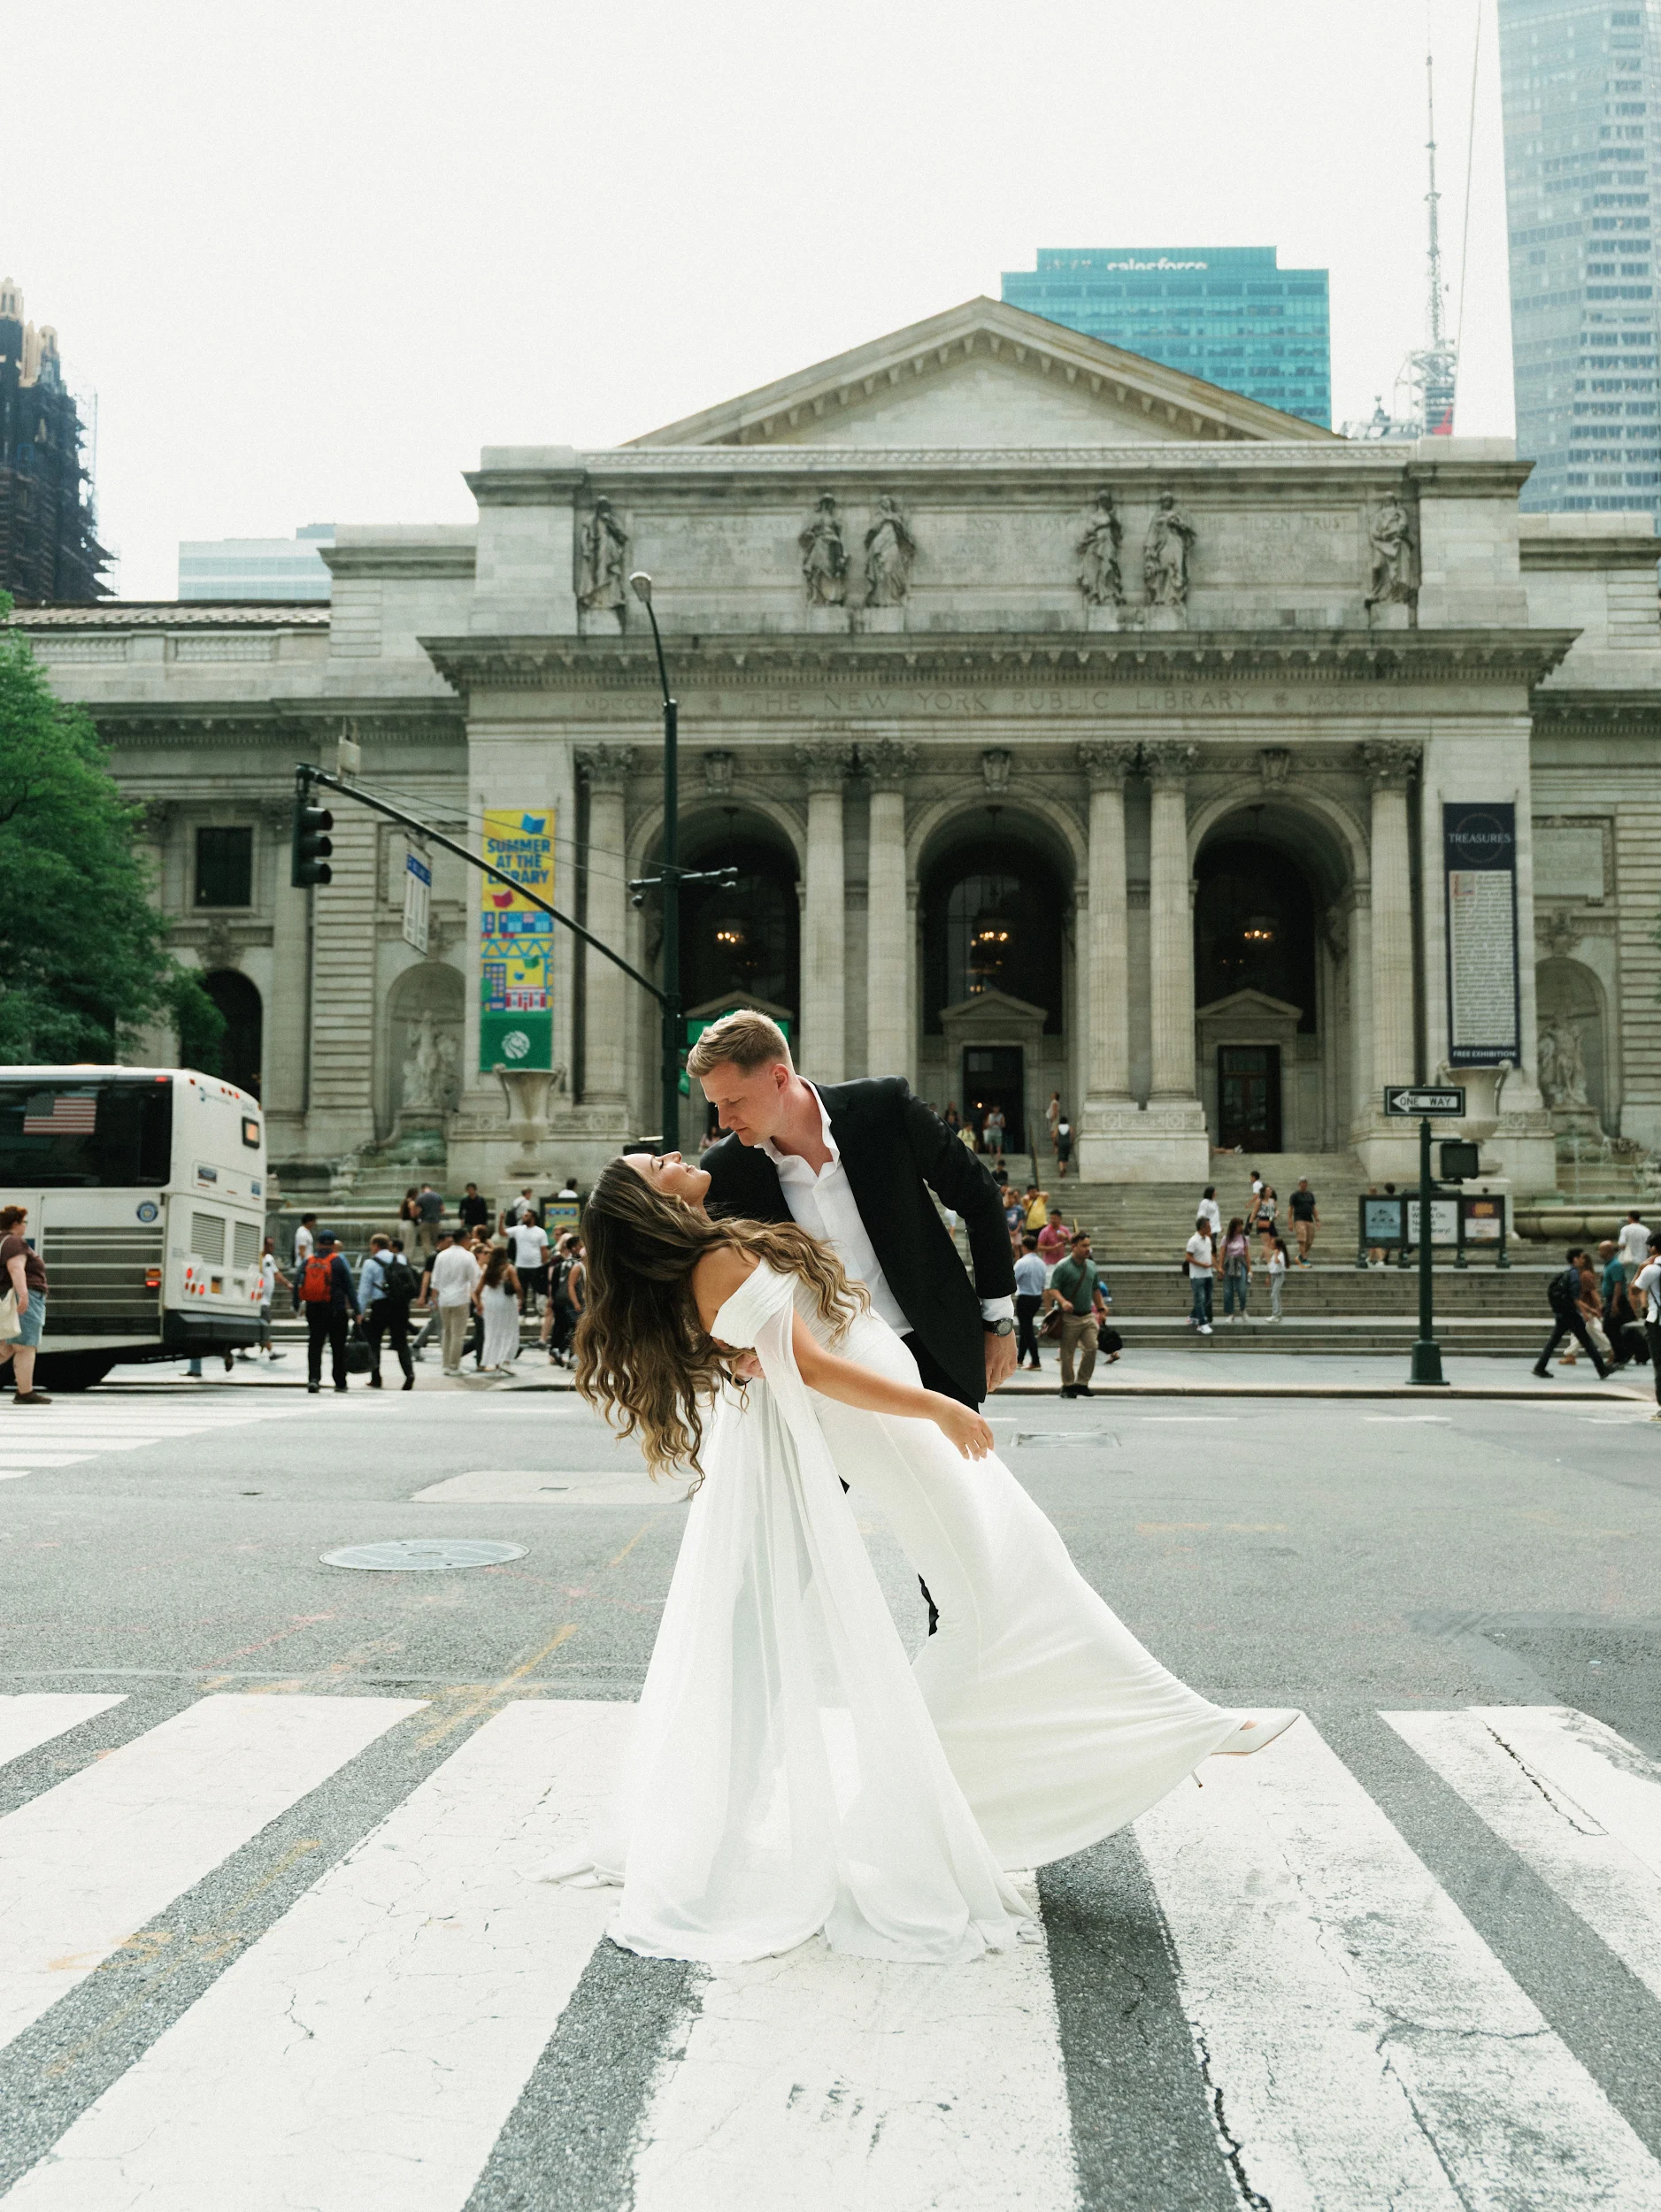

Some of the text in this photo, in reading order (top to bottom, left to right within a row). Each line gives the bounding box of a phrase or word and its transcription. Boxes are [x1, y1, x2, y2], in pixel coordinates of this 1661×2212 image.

[746, 694, 802, 712] THE
[825, 693, 892, 711] NEW
[917, 692, 989, 711] YORK
[1012, 692, 1110, 710] PUBLIC
[1135, 692, 1250, 710] LIBRARY
[1448, 832, 1511, 844] TREASURES
[488, 838, 550, 853] SUMMER
[496, 854, 542, 868] AT THE
[488, 870, 550, 884] LRARY
[1452, 1049, 1471, 1058] FREE
[1399, 1096, 1451, 1107] ONE WAY
